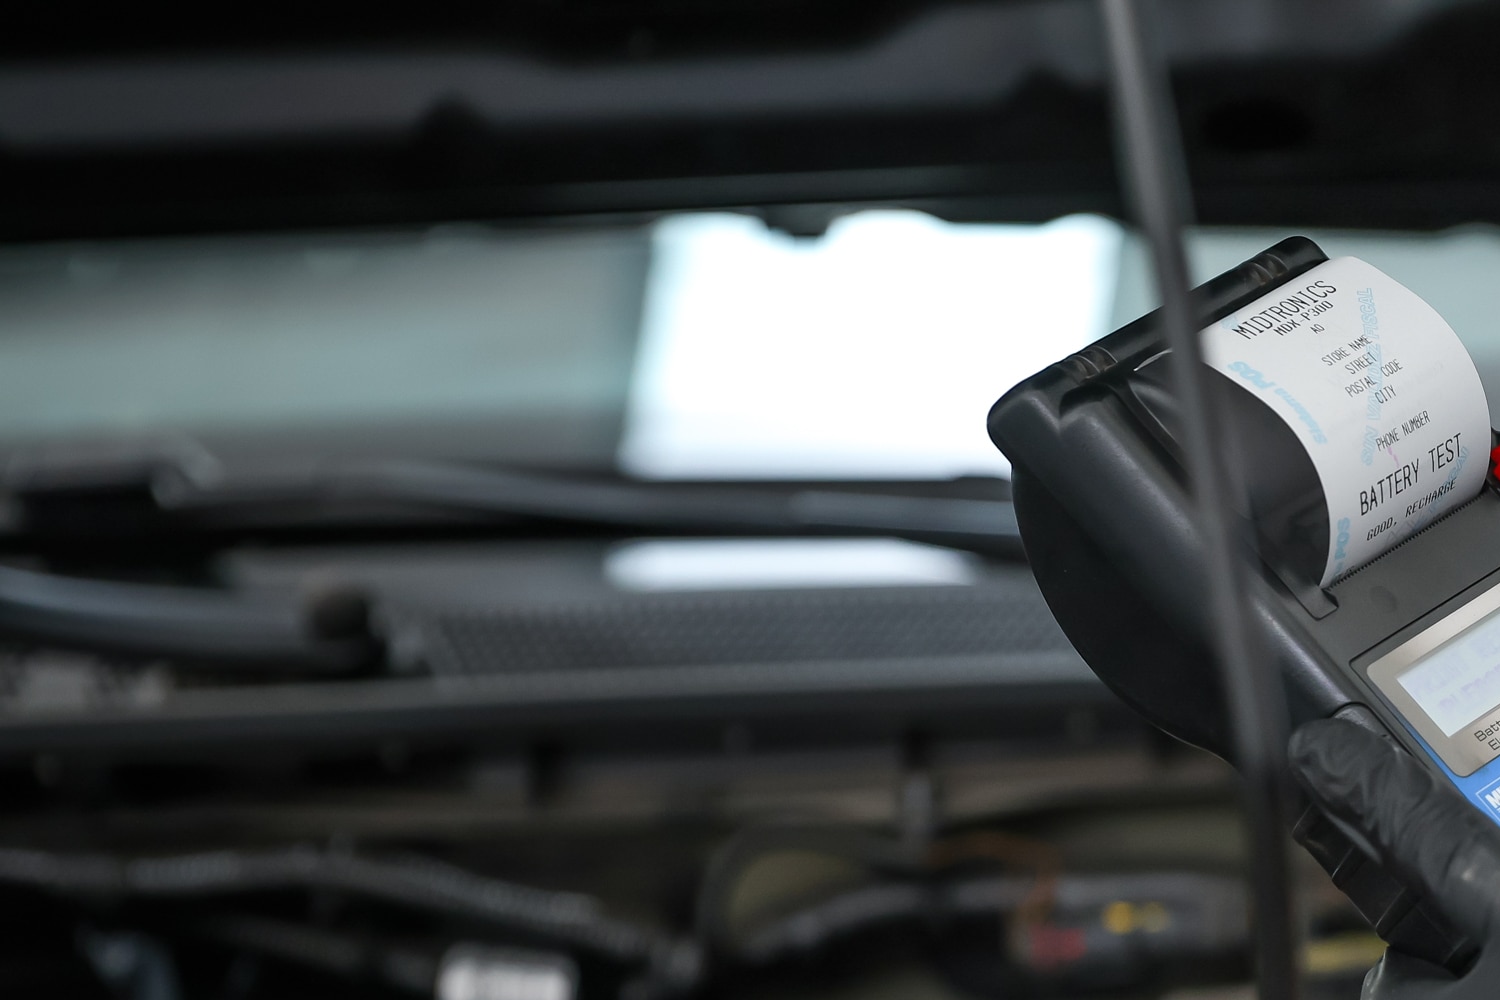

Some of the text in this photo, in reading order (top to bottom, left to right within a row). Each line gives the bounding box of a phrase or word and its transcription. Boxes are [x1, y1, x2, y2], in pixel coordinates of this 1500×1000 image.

[1232, 280, 1337, 339] MIDTRONICS
[1273, 300, 1334, 336] MDX-P300
[1322, 334, 1372, 366] STORE NAME
[1345, 351, 1377, 376] STREET
[1345, 358, 1403, 398] POSTAL CODE
[1374, 384, 1397, 405] CITY
[1376, 410, 1430, 452] PHONE NUMBER
[1360, 458, 1419, 516] BATTERY
[1427, 433, 1461, 473] TEST
[1366, 478, 1456, 542] GOOD, RECHARGE
